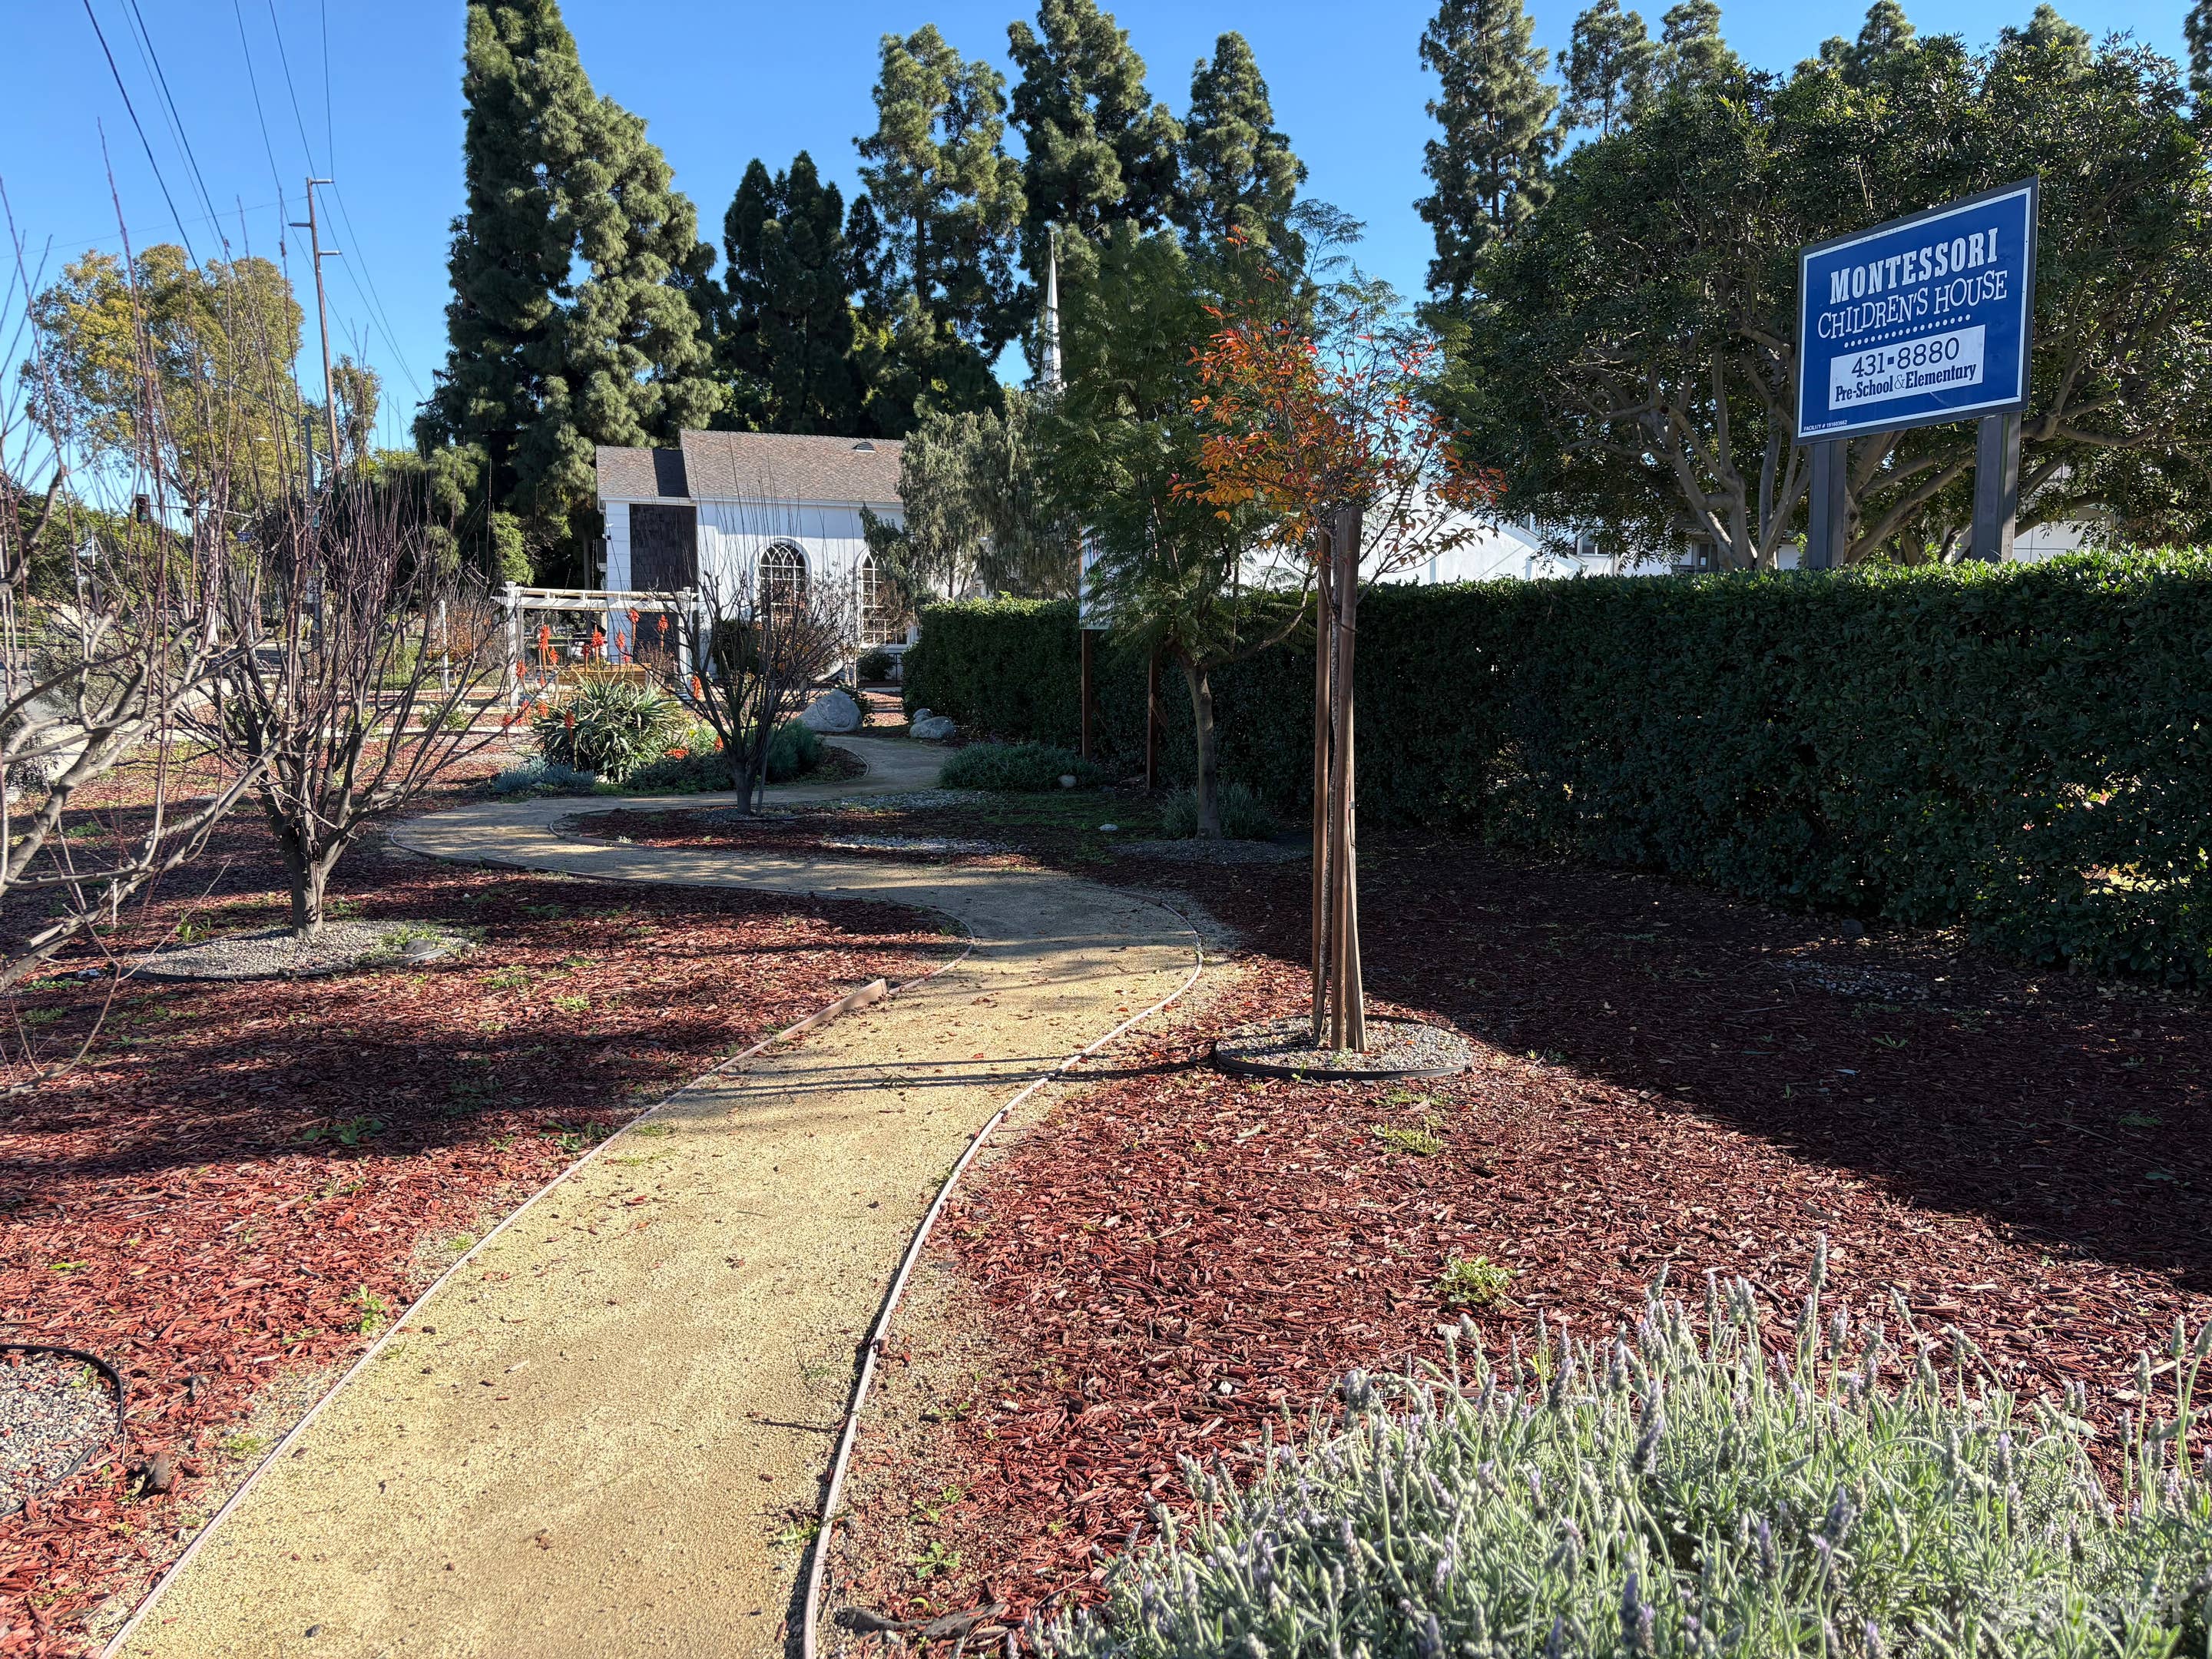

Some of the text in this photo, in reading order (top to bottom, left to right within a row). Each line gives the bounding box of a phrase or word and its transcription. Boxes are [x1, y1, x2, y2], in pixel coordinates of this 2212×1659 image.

[1830, 227, 1998, 304] MONTESSORI
[1818, 270, 2008, 339] CHILDREN'S HOUSE
[1835, 363, 1977, 402] Pre-School & Elementary
